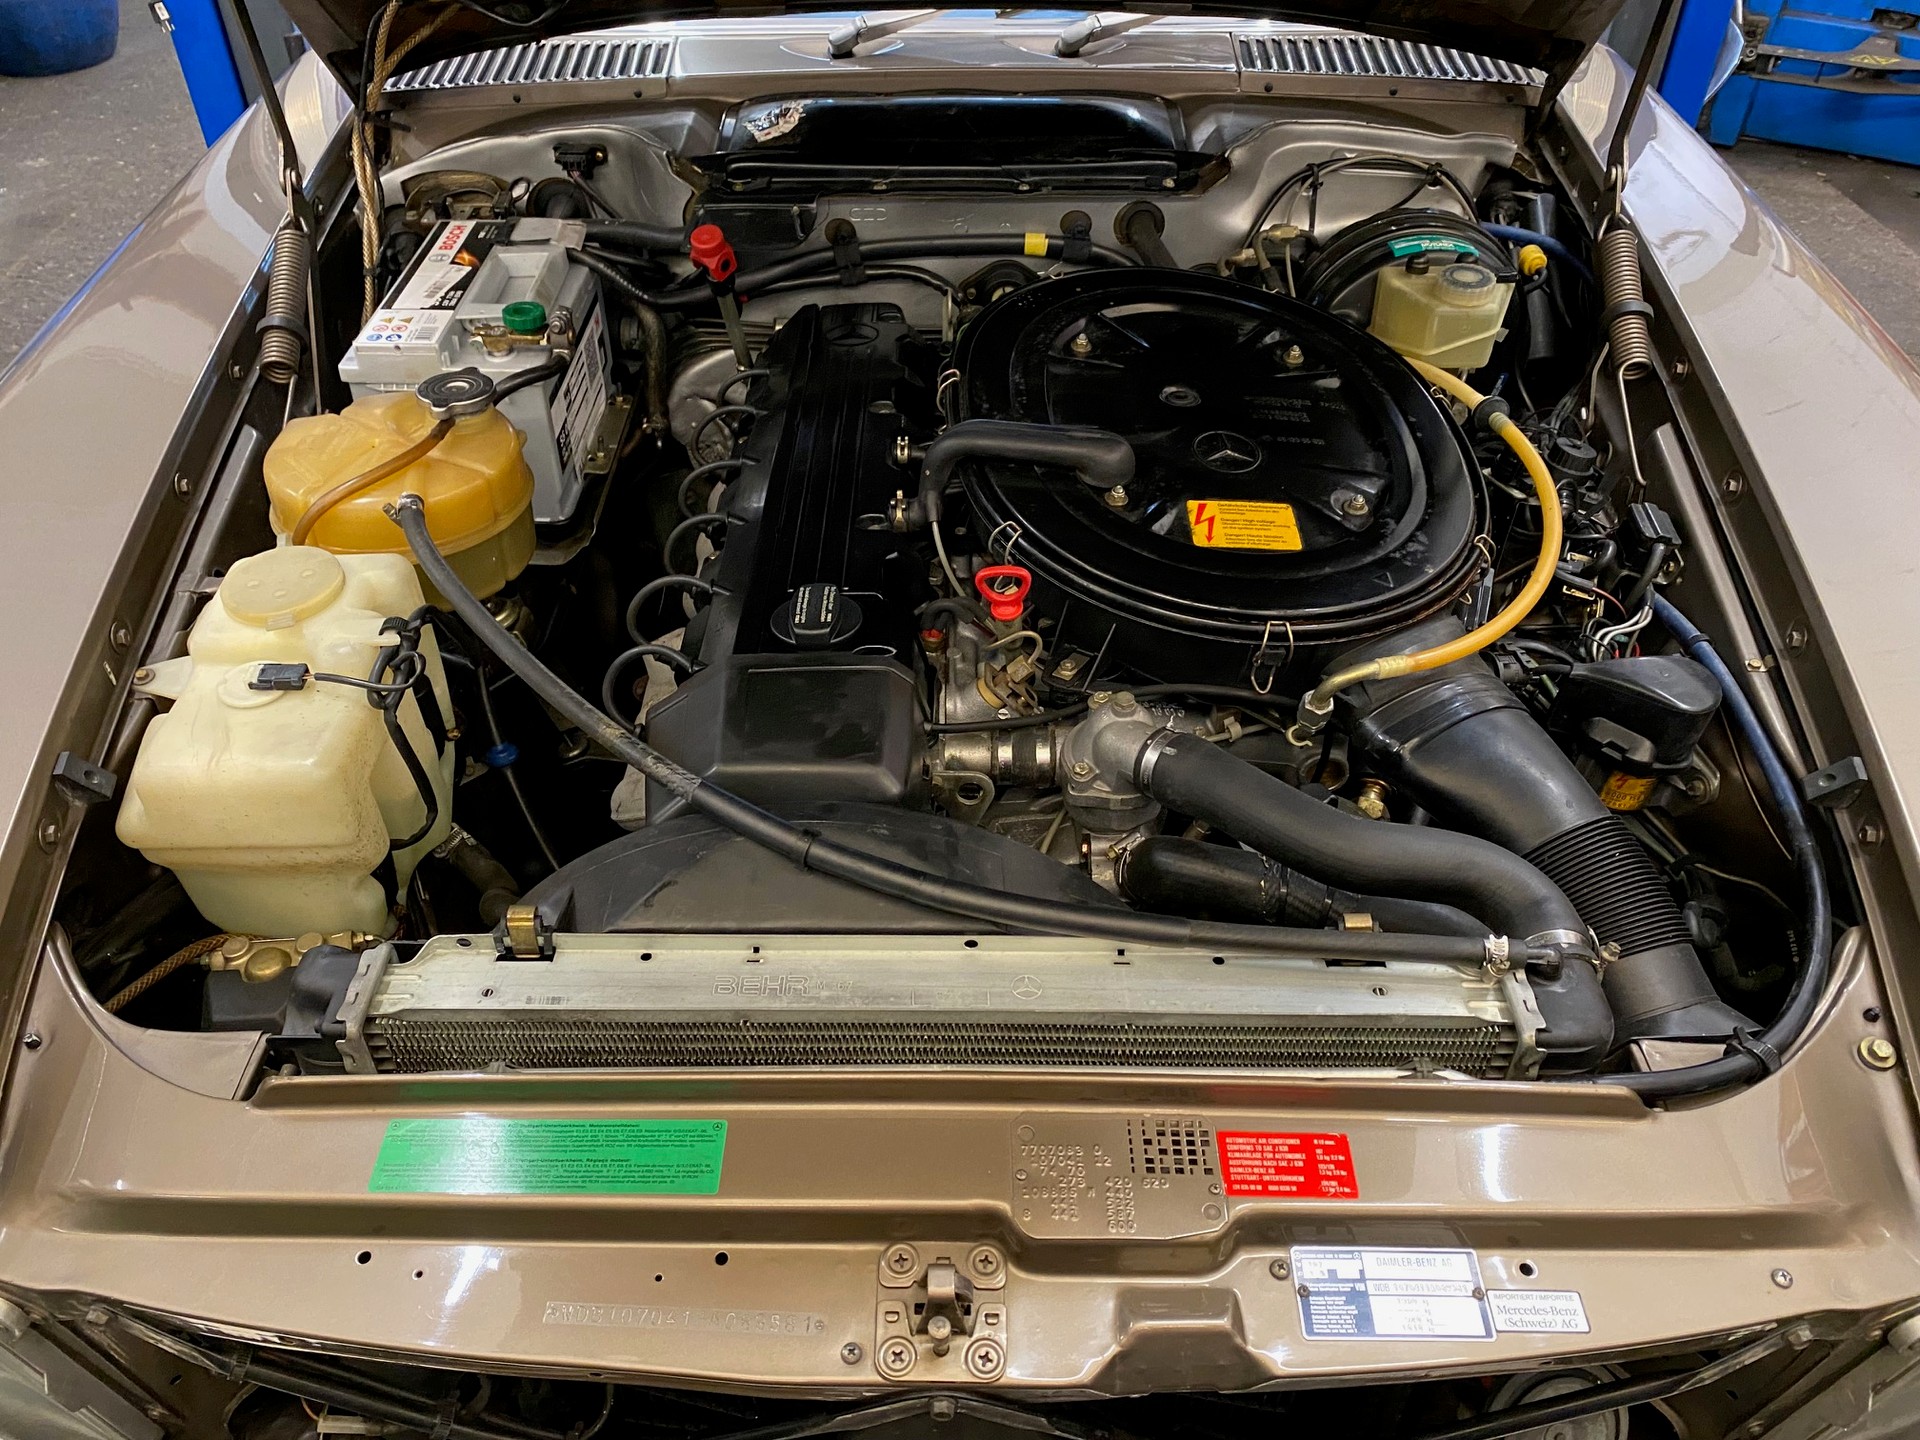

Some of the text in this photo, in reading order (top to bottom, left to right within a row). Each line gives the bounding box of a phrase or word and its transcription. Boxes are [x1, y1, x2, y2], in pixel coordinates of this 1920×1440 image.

[438, 225, 467, 251] BOSCH
[713, 975, 809, 996] BEHR
[1107, 1220, 1137, 1233] 600
[1376, 1257, 1437, 1267] DAIMLER-BENZ
[1496, 1305, 1579, 1316] Mercedes-Benz
[1505, 1318, 1578, 1329] (Schweiz) AG
